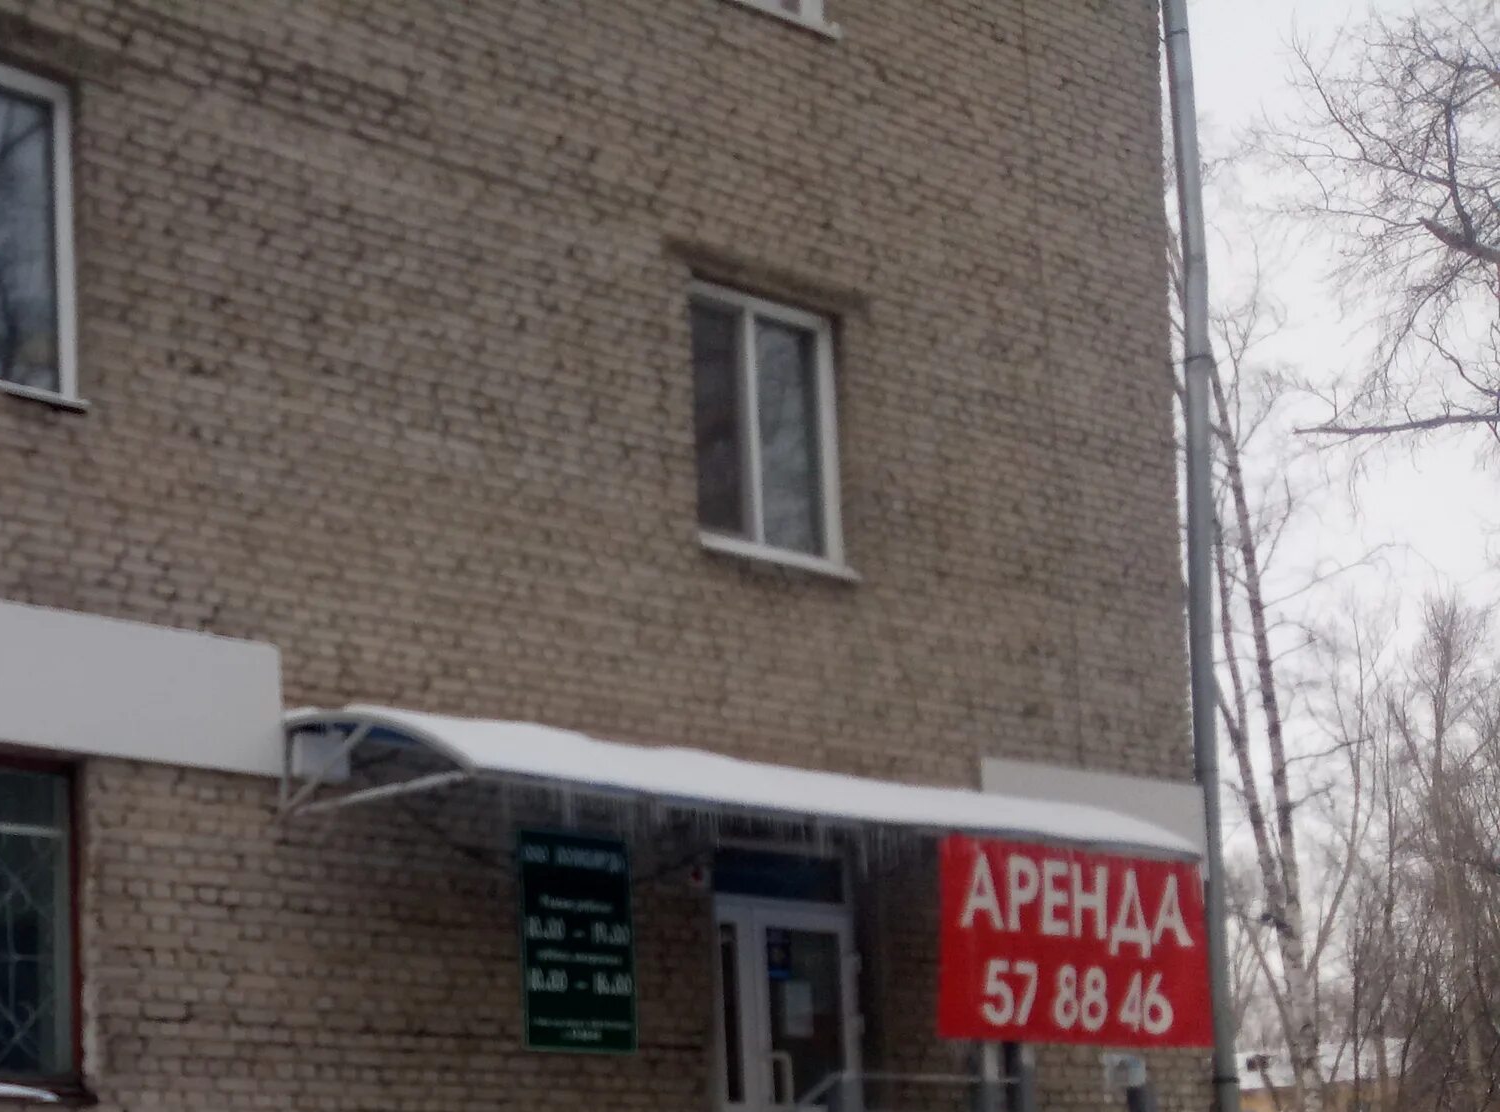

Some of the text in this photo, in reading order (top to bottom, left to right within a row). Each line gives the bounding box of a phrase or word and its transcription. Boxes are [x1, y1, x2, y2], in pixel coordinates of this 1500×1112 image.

[958, 852, 1195, 959] АРЕНДА
[981, 958, 1174, 1035] 57 88 46
